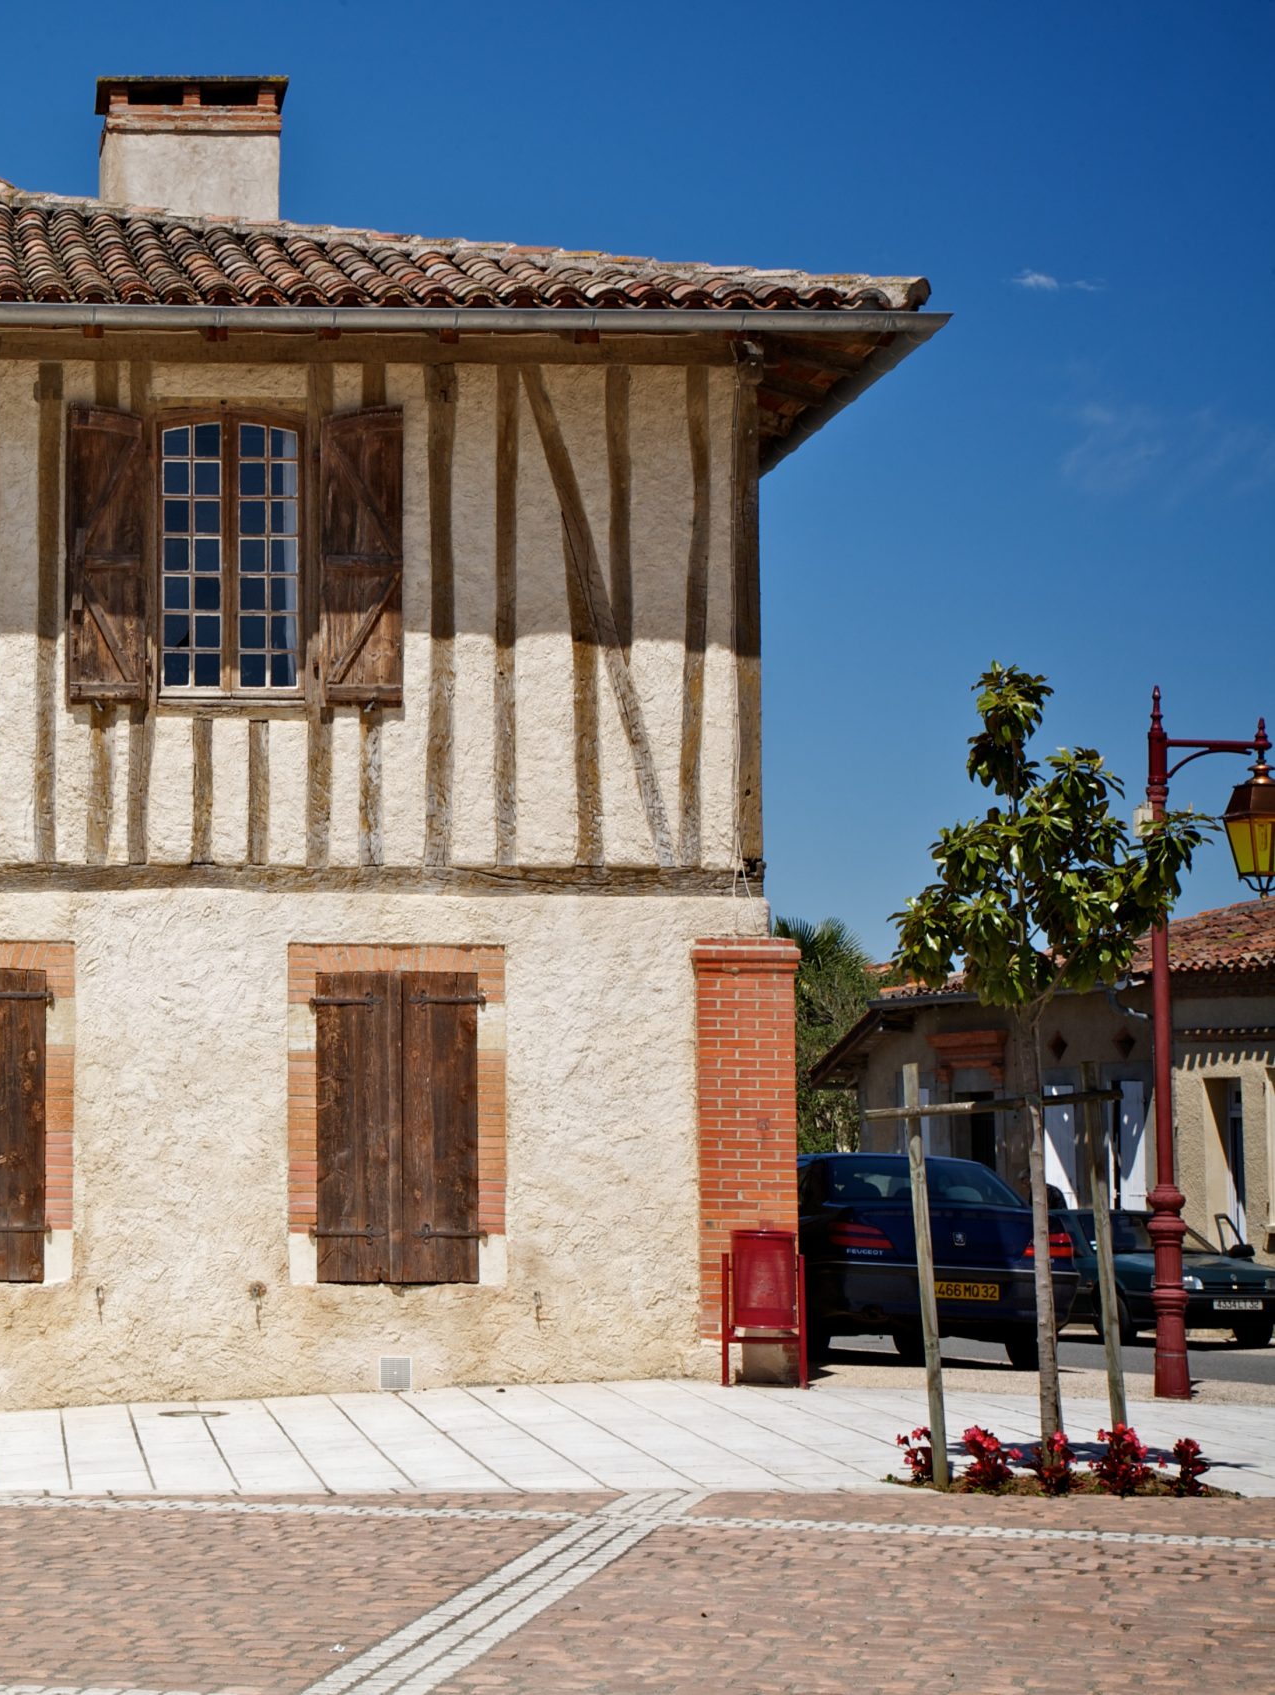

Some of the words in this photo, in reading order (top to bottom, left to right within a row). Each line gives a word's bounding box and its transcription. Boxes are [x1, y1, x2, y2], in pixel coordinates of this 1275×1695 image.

[846, 1247, 884, 1256] PEUGEOT
[934, 1283, 962, 1297] 466
[981, 1285, 997, 1299] 32
